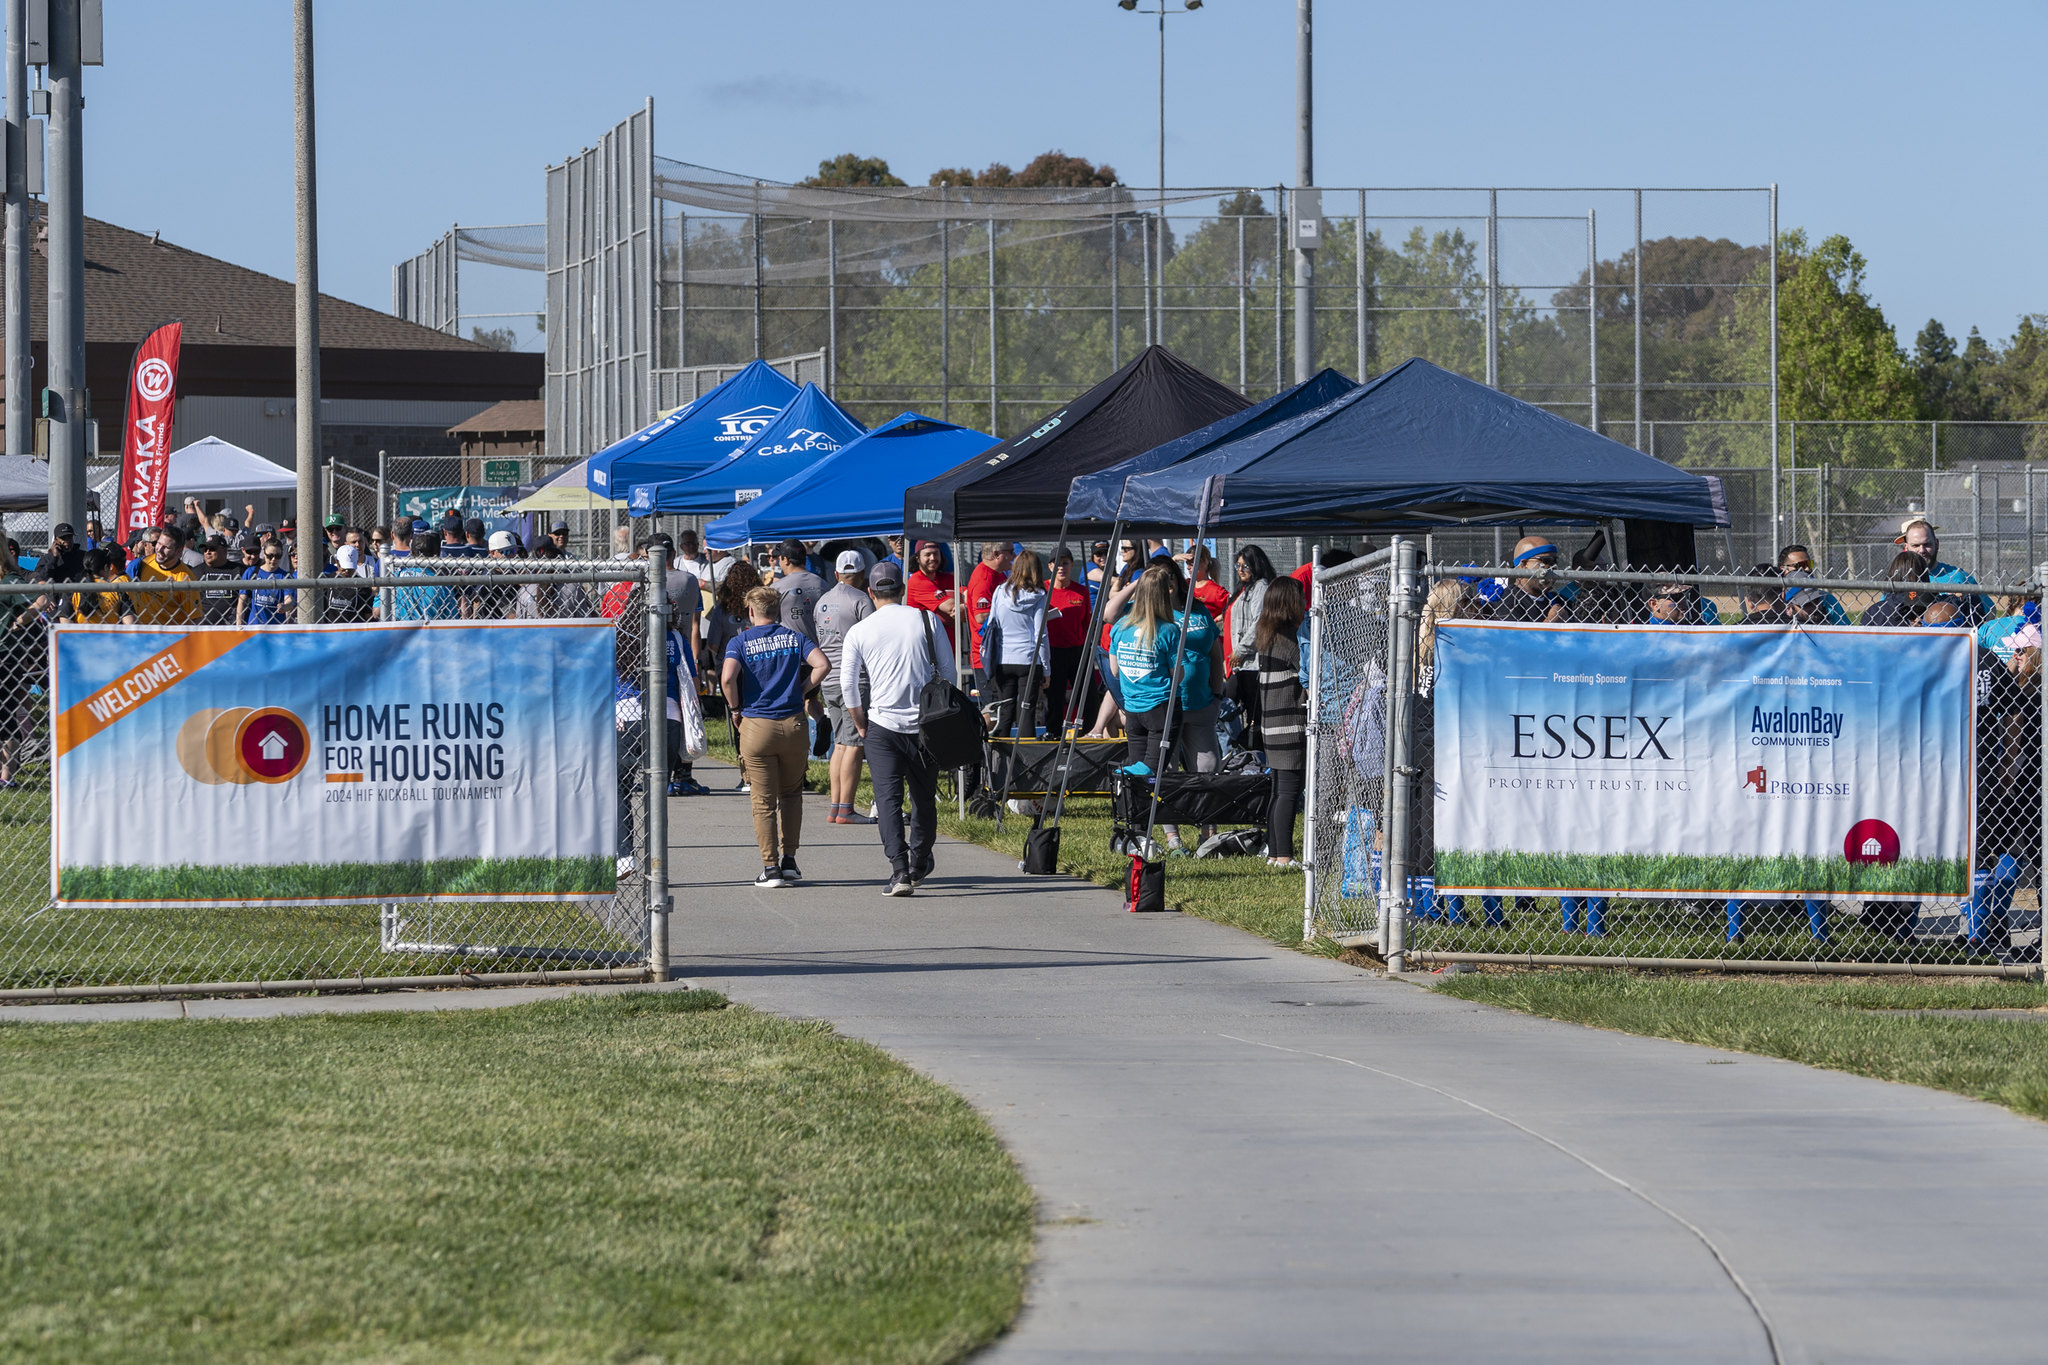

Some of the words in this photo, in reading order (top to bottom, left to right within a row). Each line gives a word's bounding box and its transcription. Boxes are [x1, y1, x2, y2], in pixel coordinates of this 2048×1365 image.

[155, 422, 165, 457] Friends
[757, 440, 842, 456] C&APain
[154, 458, 162, 467] &
[495, 461, 511, 470] NO
[130, 413, 157, 529] BWAKA
[150, 468, 163, 503] Parties,
[430, 496, 470, 510] Sutter
[470, 494, 513, 508] Health
[150, 504, 159, 527] orts,
[1553, 672, 1594, 686] Presenting
[1595, 672, 1627, 685] Sponsor
[1752, 675, 1783, 686] Diamond
[1784, 676, 1808, 686] Double
[1809, 676, 1843, 688] Sponsors
[86, 653, 184, 723] WELCOME!
[324, 703, 411, 742] HOME
[422, 702, 505, 740] RUNS
[1751, 705, 1844, 739] AvalonBay
[1509, 713, 1675, 761] ESSEX
[1751, 736, 1830, 747] COMMUNITIES
[325, 745, 363, 771] FOR
[370, 743, 505, 782] HOUSING
[1488, 777, 1578, 791] PROPERTY
[1587, 779, 1647, 792] TRUST,
[1656, 780, 1692, 792] INC.
[1770, 780, 1850, 796] PRODESSE
[326, 789, 352, 803] 2024
[356, 788, 374, 802] HIF
[377, 787, 428, 801] KICKBALL
[432, 786, 504, 801] TOURNAMENT
[1861, 844, 1882, 856] HIF
